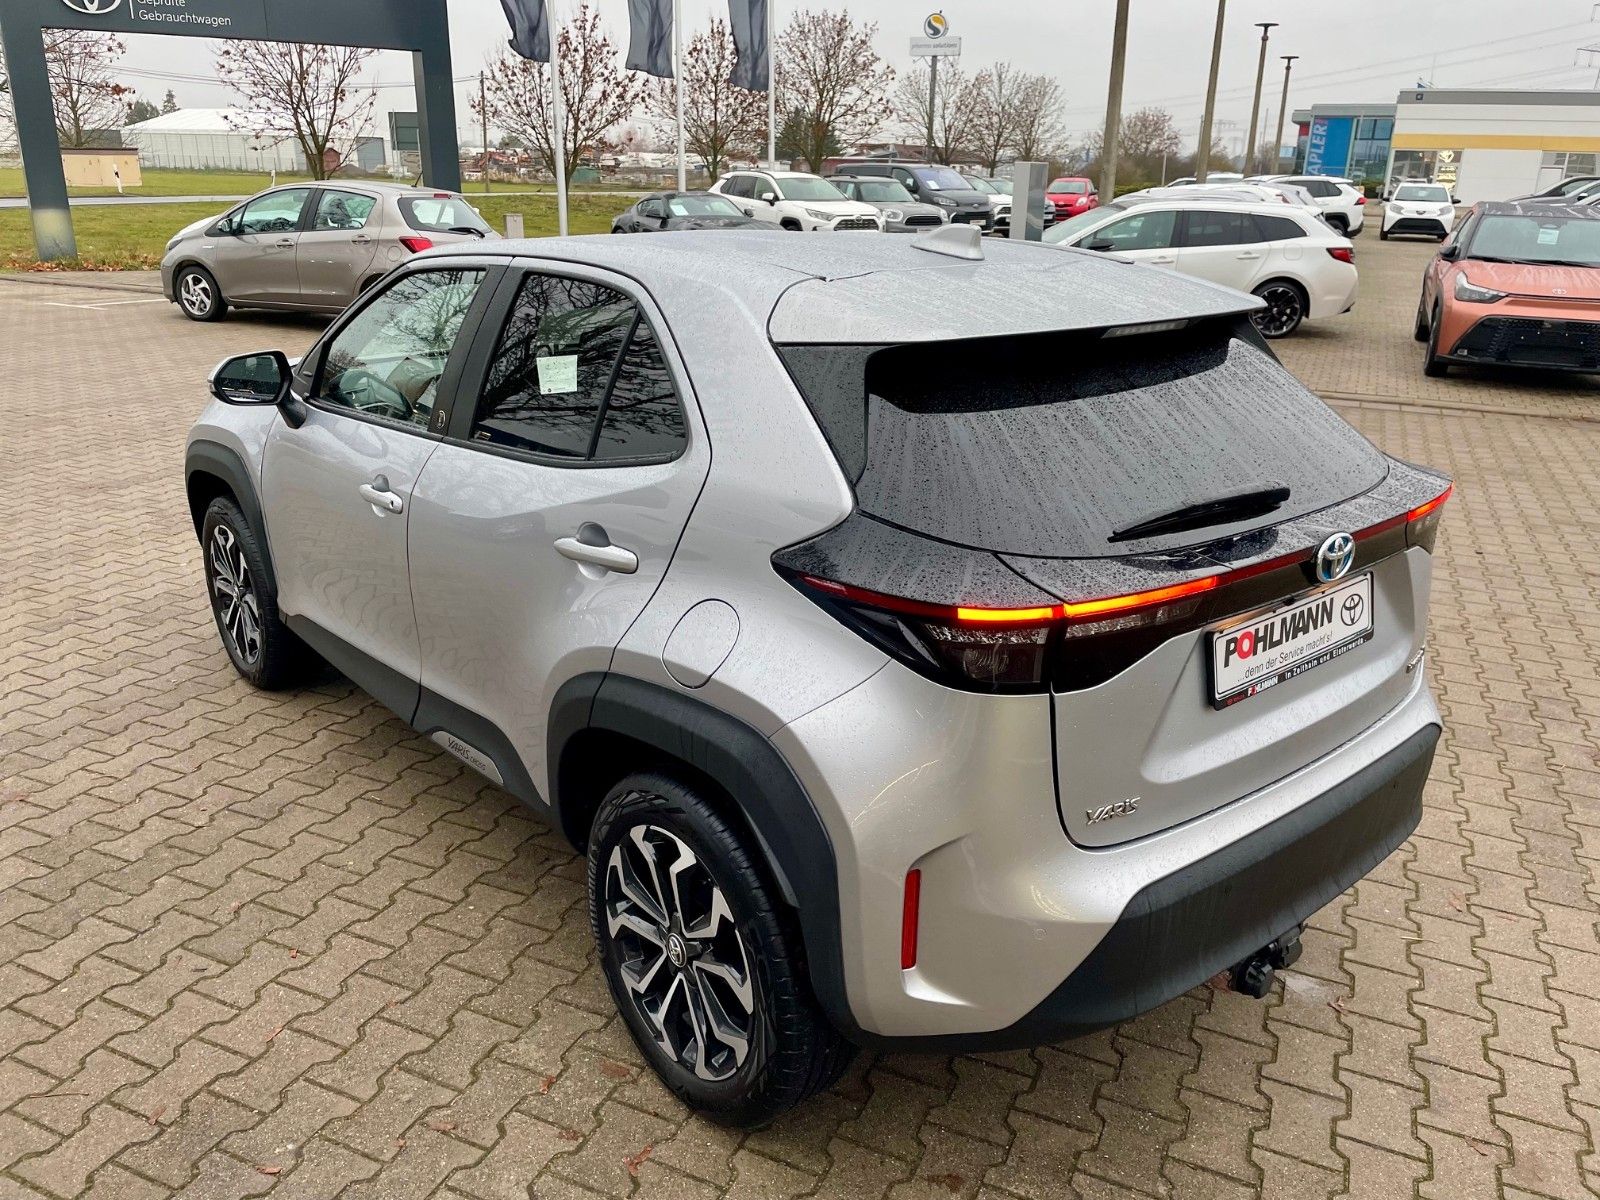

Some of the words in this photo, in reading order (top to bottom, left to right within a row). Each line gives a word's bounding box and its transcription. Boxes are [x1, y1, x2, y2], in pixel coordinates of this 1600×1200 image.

[138, 9, 232, 27] Gebrauchtwagen
[1307, 122, 1329, 176] APLER
[1224, 597, 1334, 669] POHLMANN
[1265, 656, 1278, 671] der
[1279, 645, 1305, 665] Service
[448, 736, 470, 760] YARIS
[1085, 796, 1141, 826] YARIS
